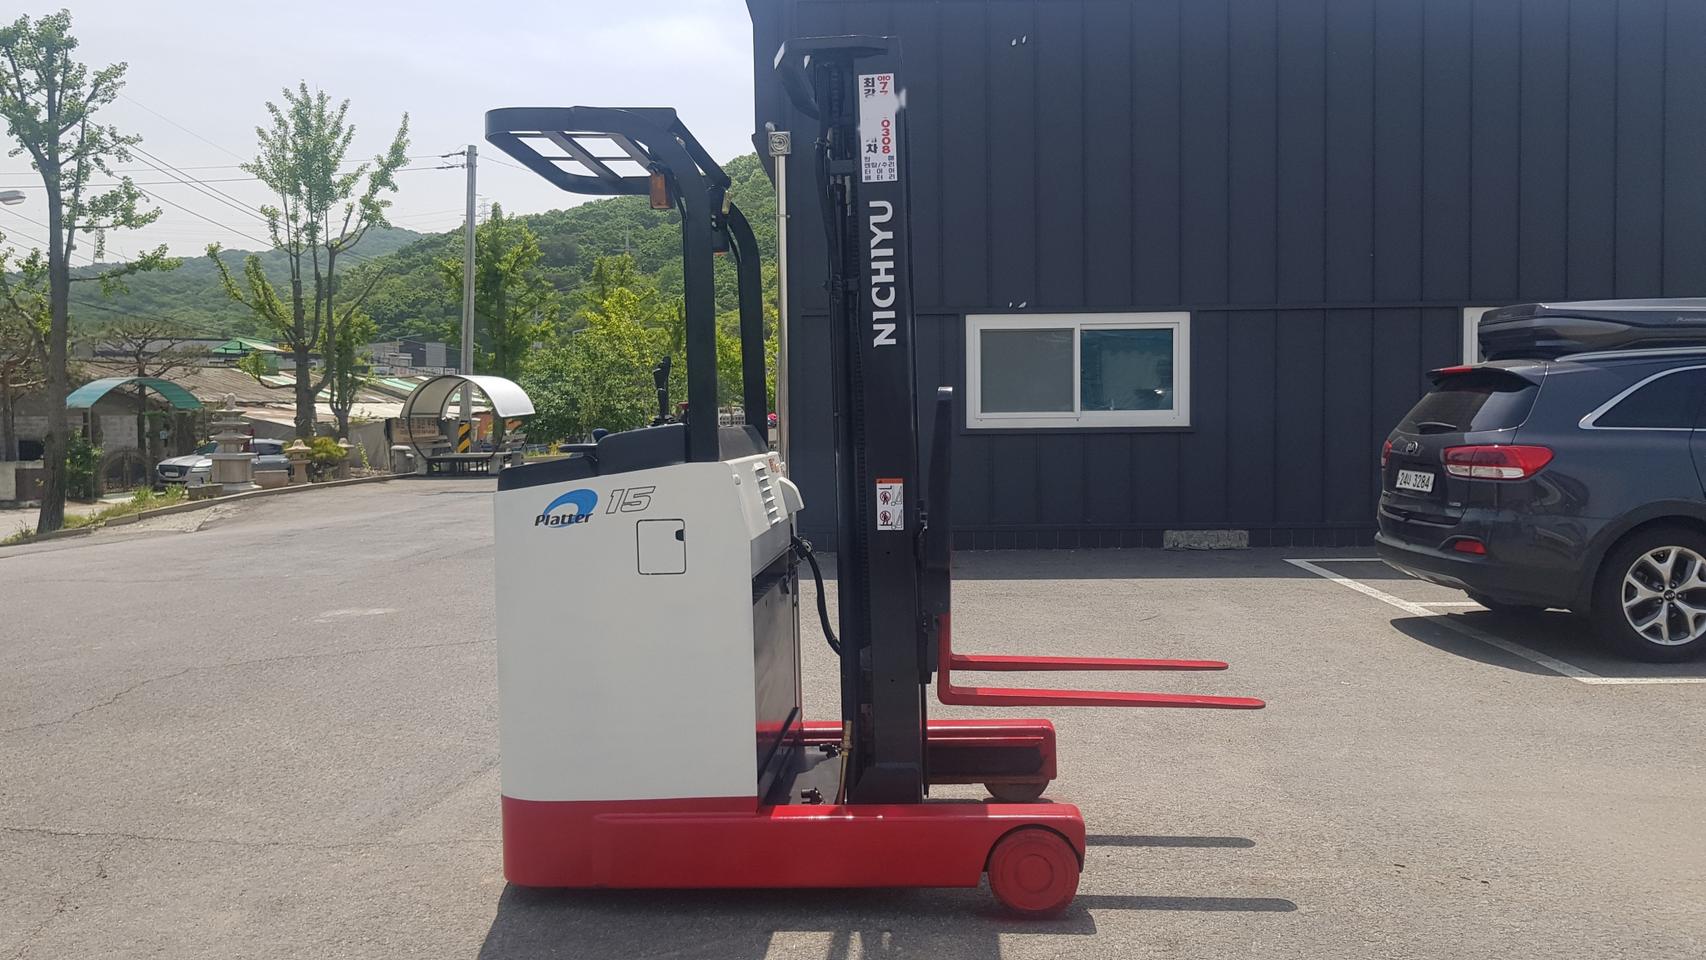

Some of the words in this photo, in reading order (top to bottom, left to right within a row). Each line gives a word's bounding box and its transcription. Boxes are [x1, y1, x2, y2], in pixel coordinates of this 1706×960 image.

[881, 119, 891, 154] 0308
[869, 201, 897, 348] NICHIYU
[1412, 473, 1431, 490] 3284
[534, 512, 594, 527] Platter
[605, 485, 656, 515] 15
